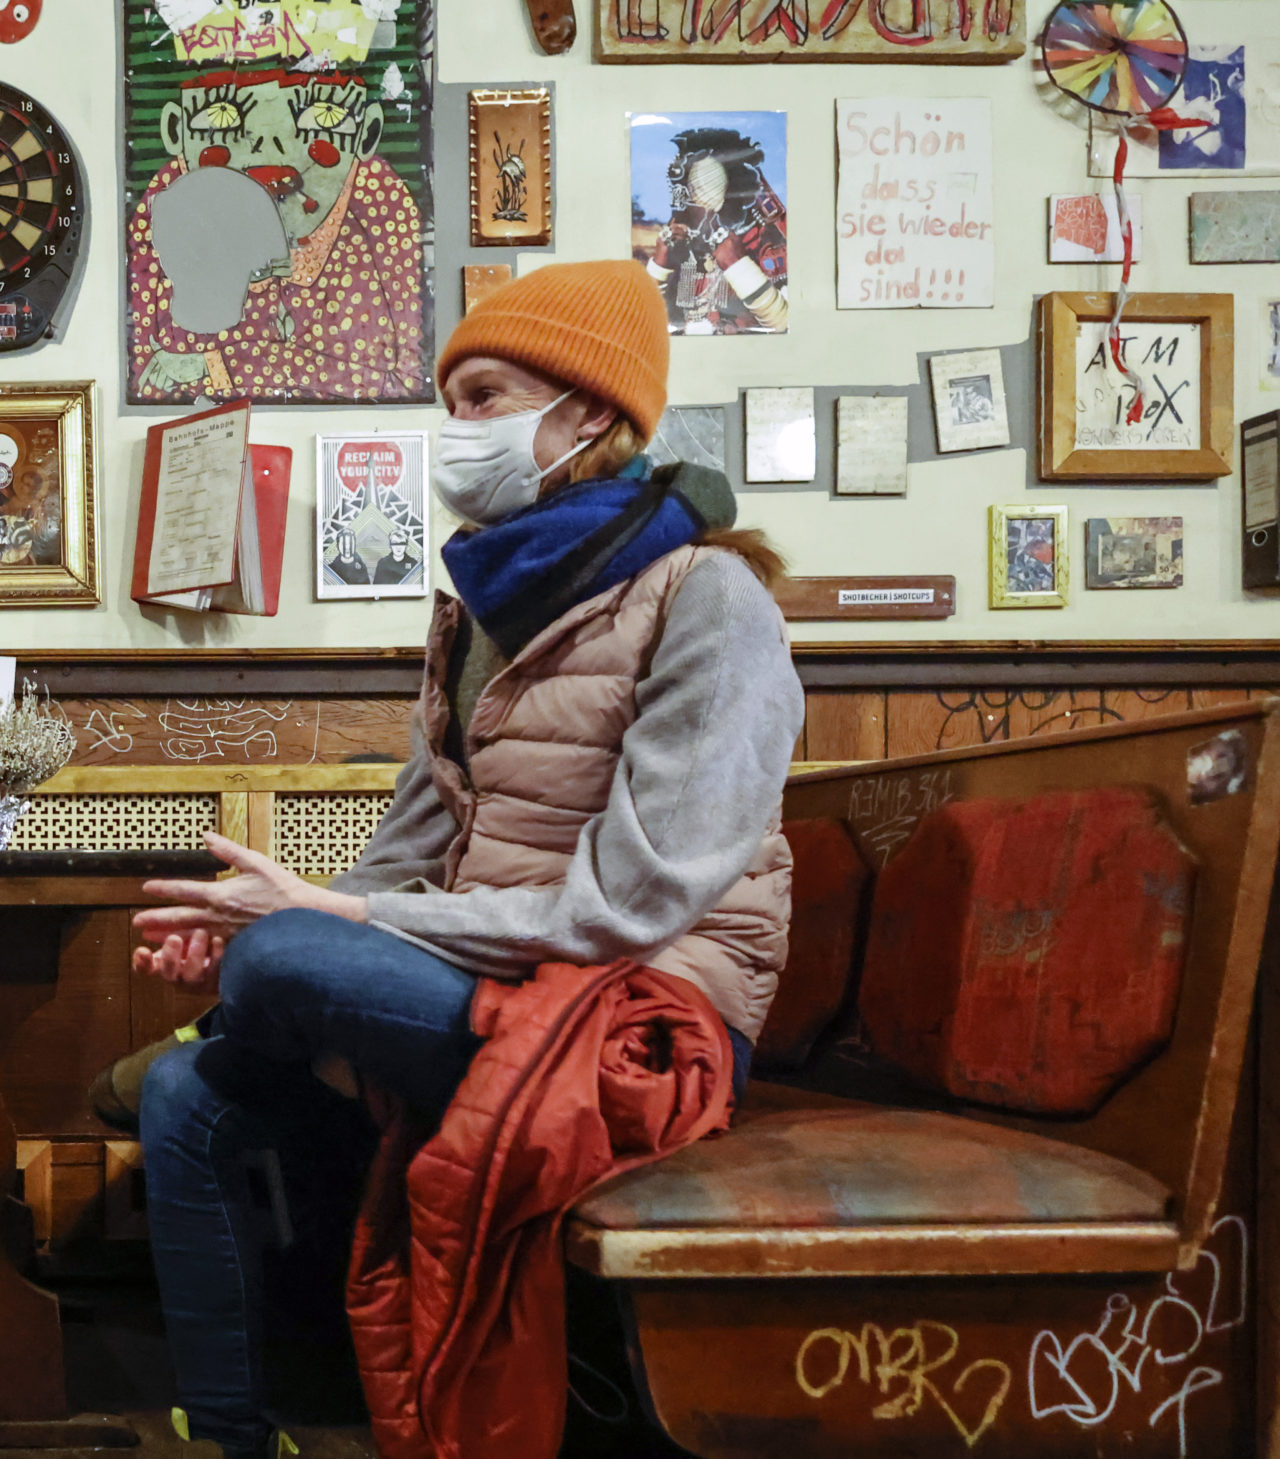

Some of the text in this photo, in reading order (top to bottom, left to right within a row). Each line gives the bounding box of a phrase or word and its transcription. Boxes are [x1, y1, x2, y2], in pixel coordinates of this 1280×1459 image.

[20, 101, 33, 112] 18
[46, 124, 53, 134] 4
[841, 111, 965, 157] Schön
[58, 152, 70, 164] 13
[862, 162, 937, 203] dass
[65, 184, 73, 196] 6
[58, 216, 71, 228] 10
[898, 201, 992, 241] wieder
[44, 244, 56, 256] 15
[864, 237, 905, 265] da
[24, 267, 31, 278] 2
[375, 465, 401, 477] CITY
[893, 592, 930, 600] SHOTCUPS
